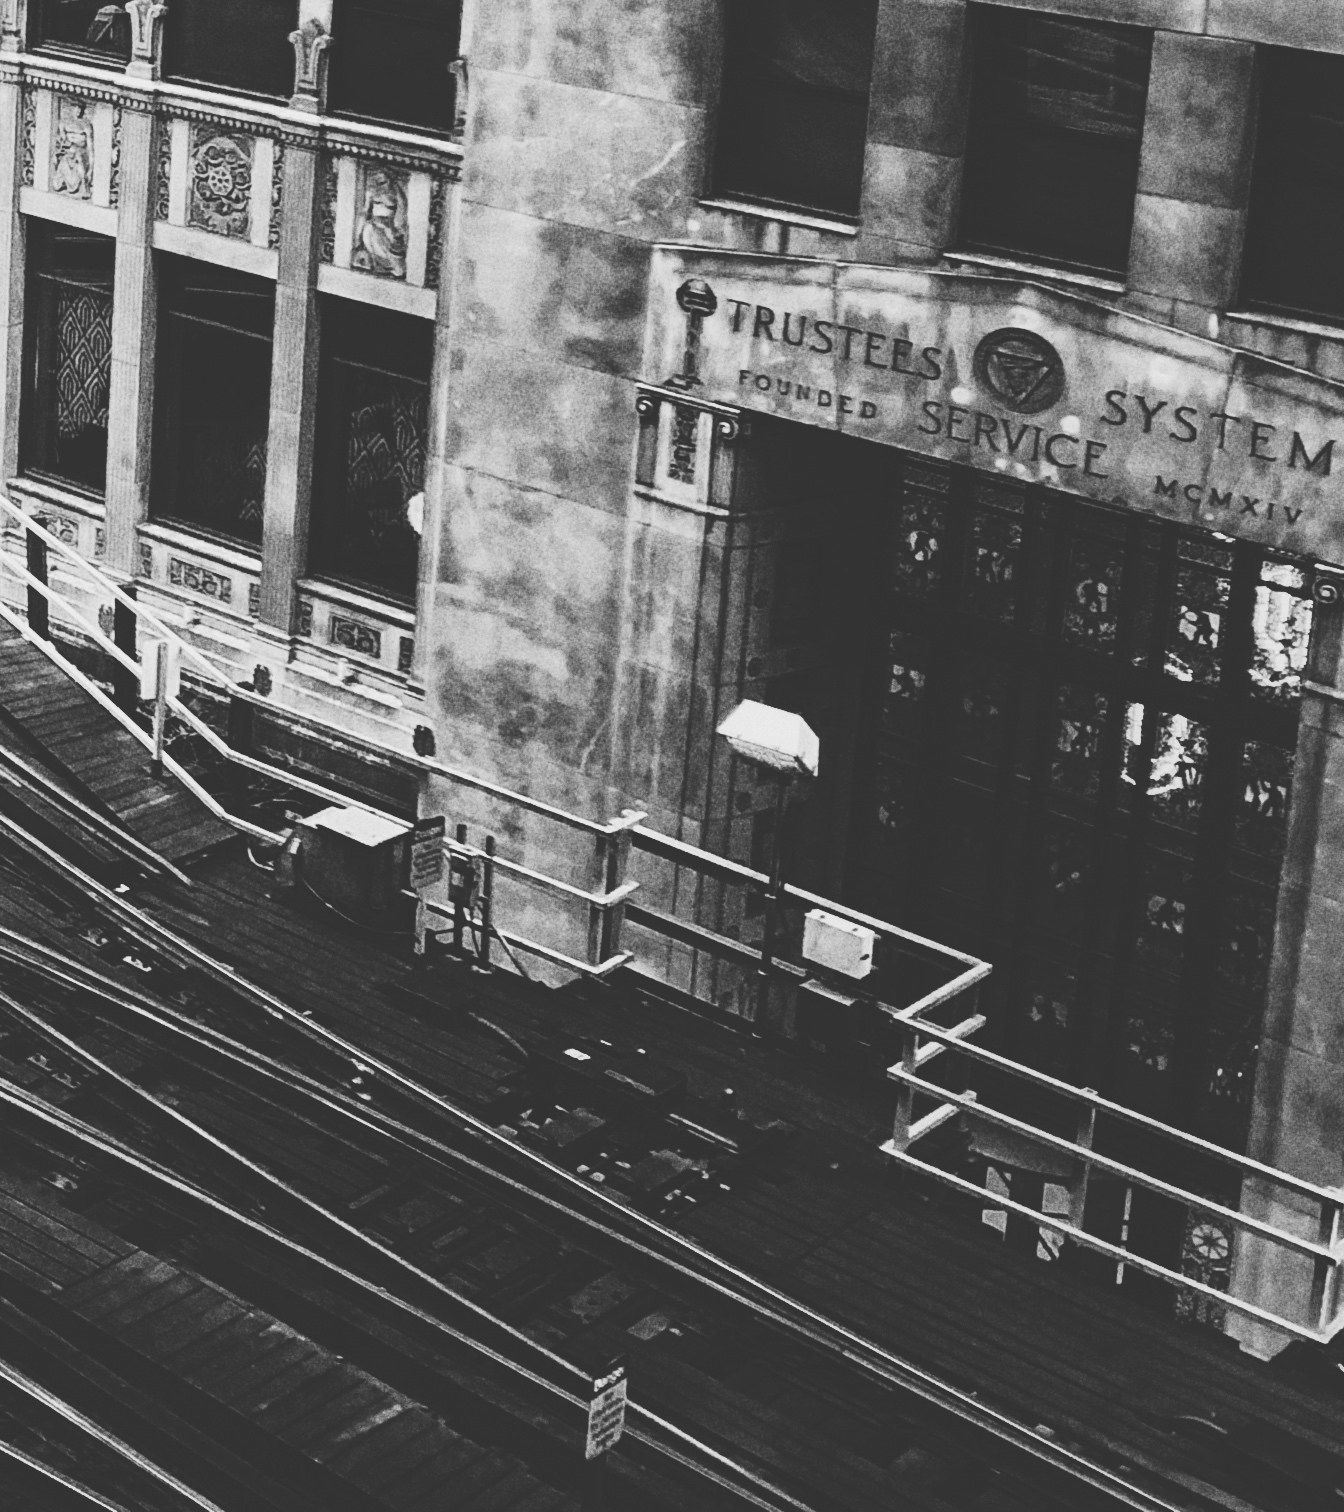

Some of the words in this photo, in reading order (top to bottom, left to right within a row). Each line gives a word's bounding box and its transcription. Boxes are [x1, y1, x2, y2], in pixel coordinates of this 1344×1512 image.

[726, 298, 943, 381] TRUSTEES
[1099, 389, 1337, 477] SYSTEM
[738, 369, 878, 420] FOUNDED
[1154, 475, 1303, 525] MCMXIV
[916, 400, 1109, 479] SERVICE
